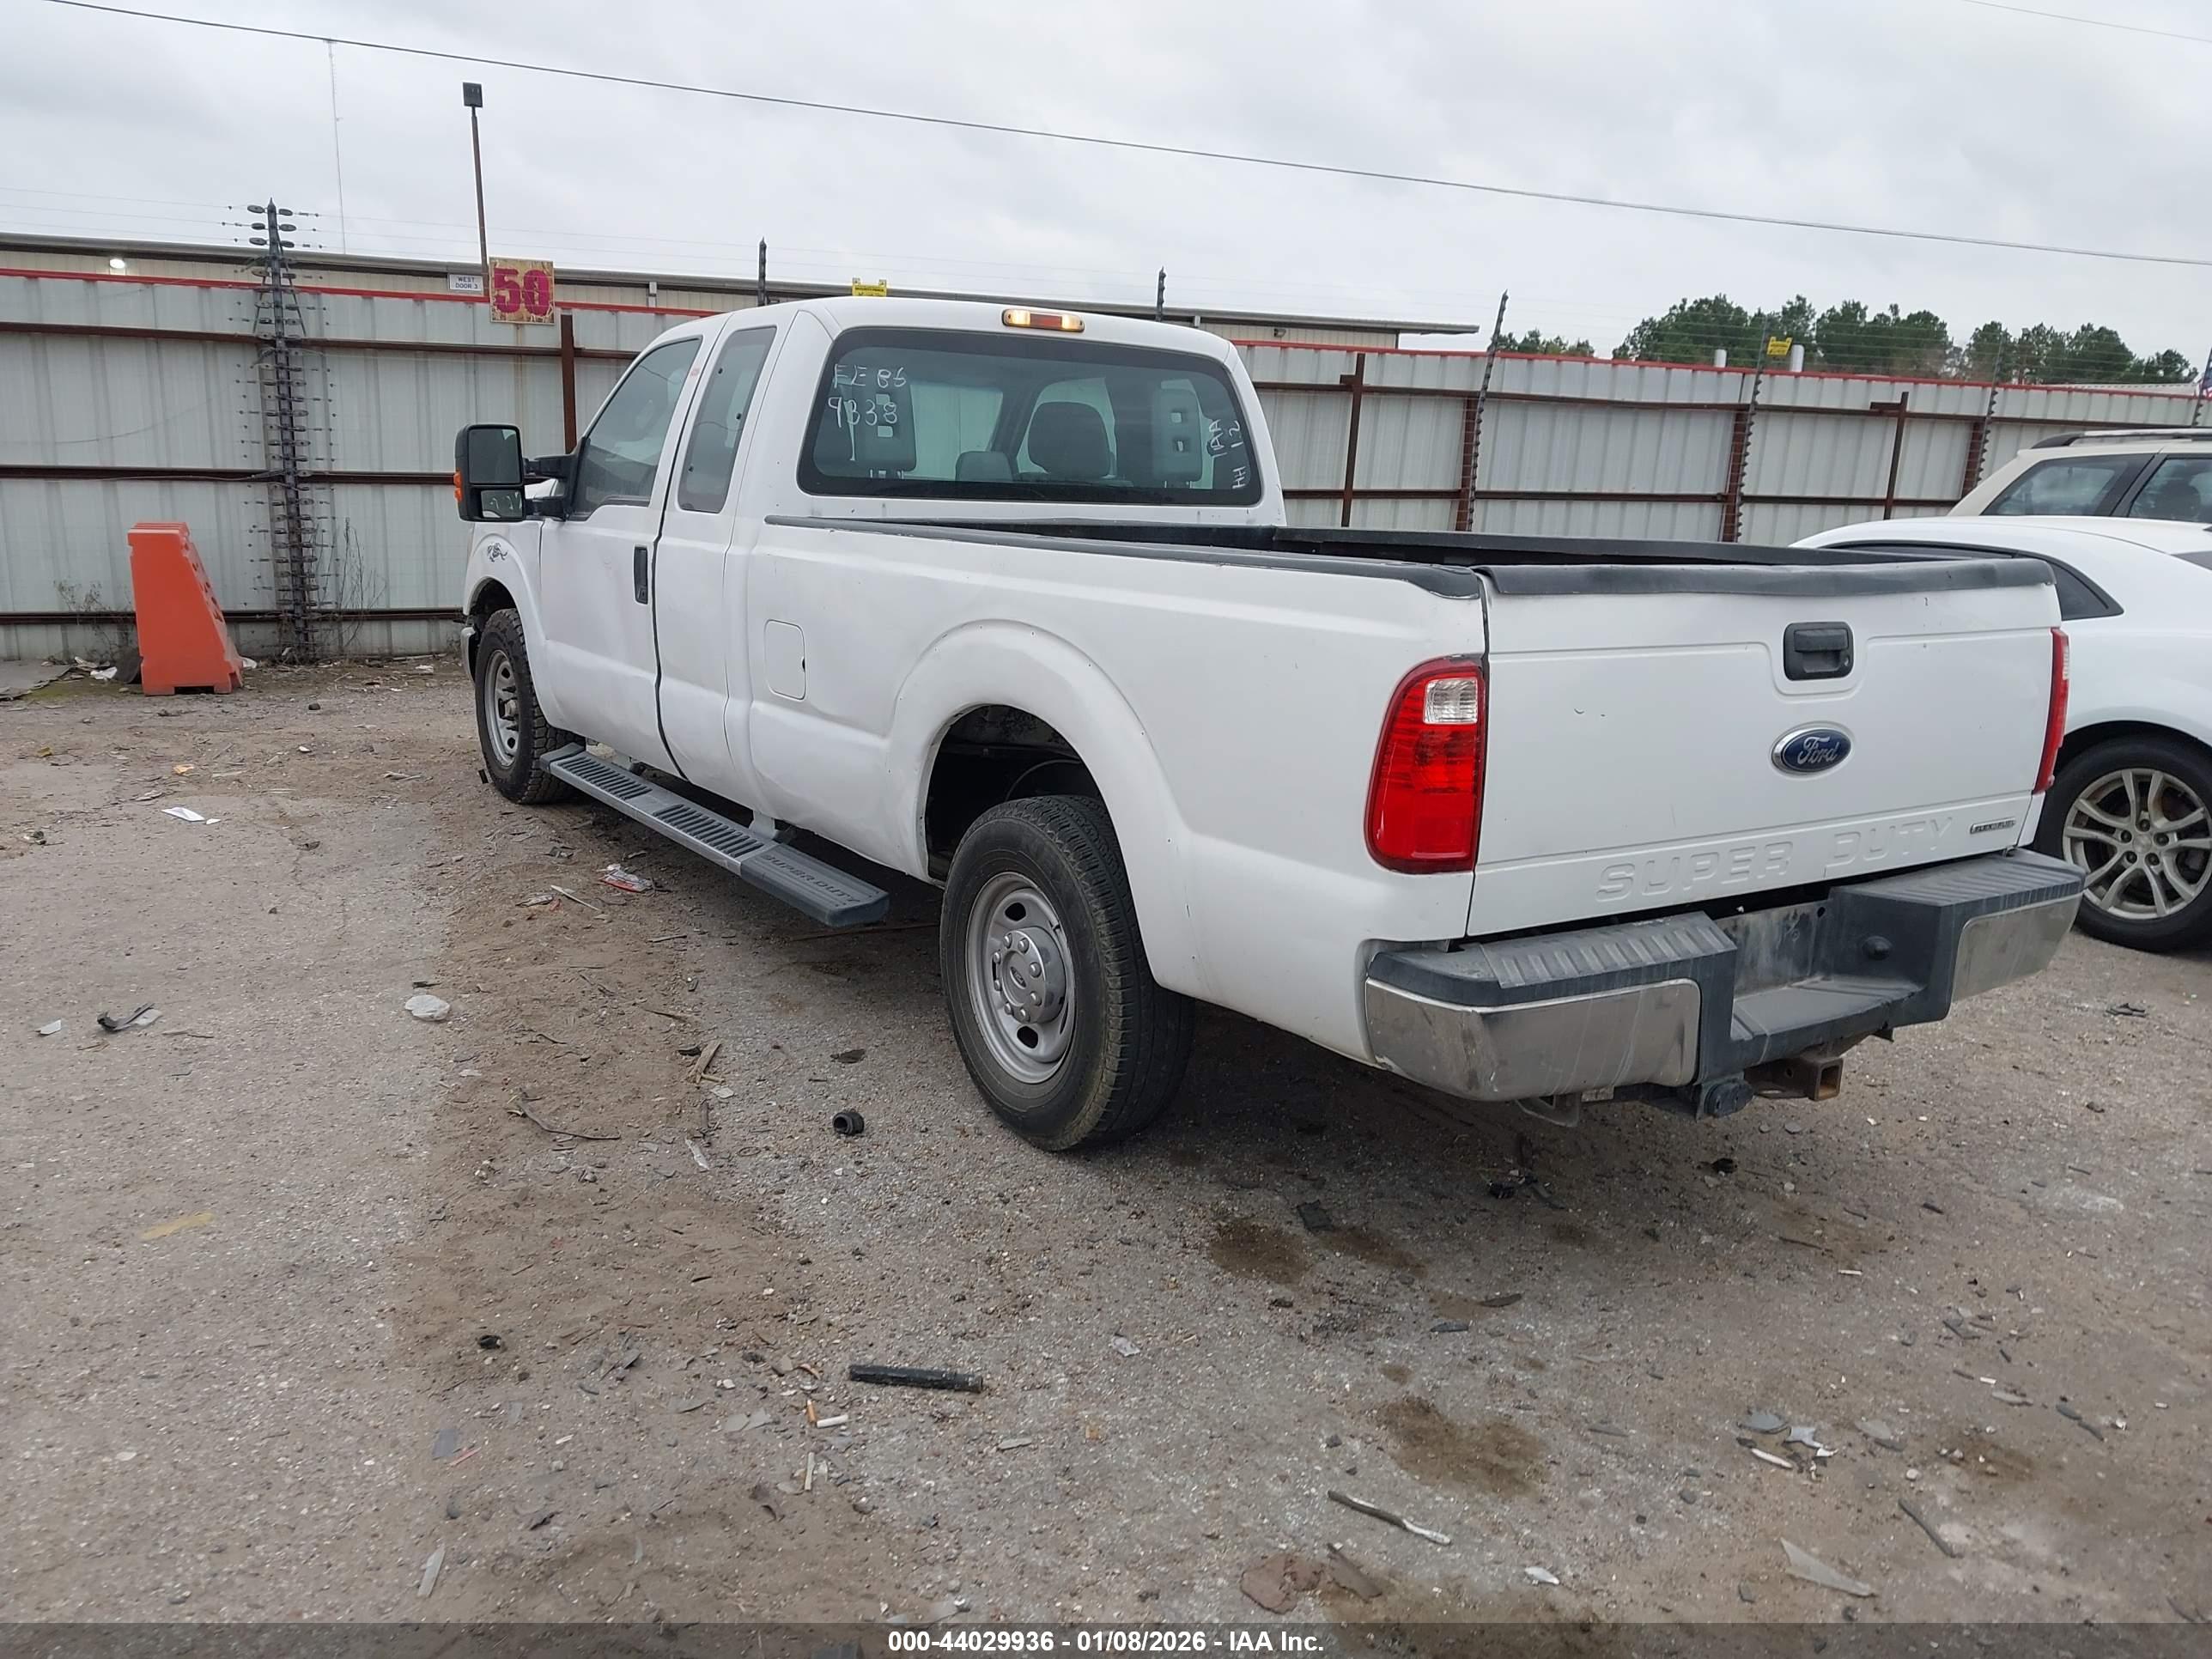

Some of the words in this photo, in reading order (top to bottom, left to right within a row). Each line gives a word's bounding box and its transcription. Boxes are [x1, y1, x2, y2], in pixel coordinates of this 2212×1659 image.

[493, 267, 551, 317] 50
[1797, 736, 1840, 764] Ford
[763, 854, 815, 882] SUPER
[814, 880, 860, 902] DUTY
[1595, 841, 1794, 902] SUPER
[1826, 817, 1954, 869] DUTY
